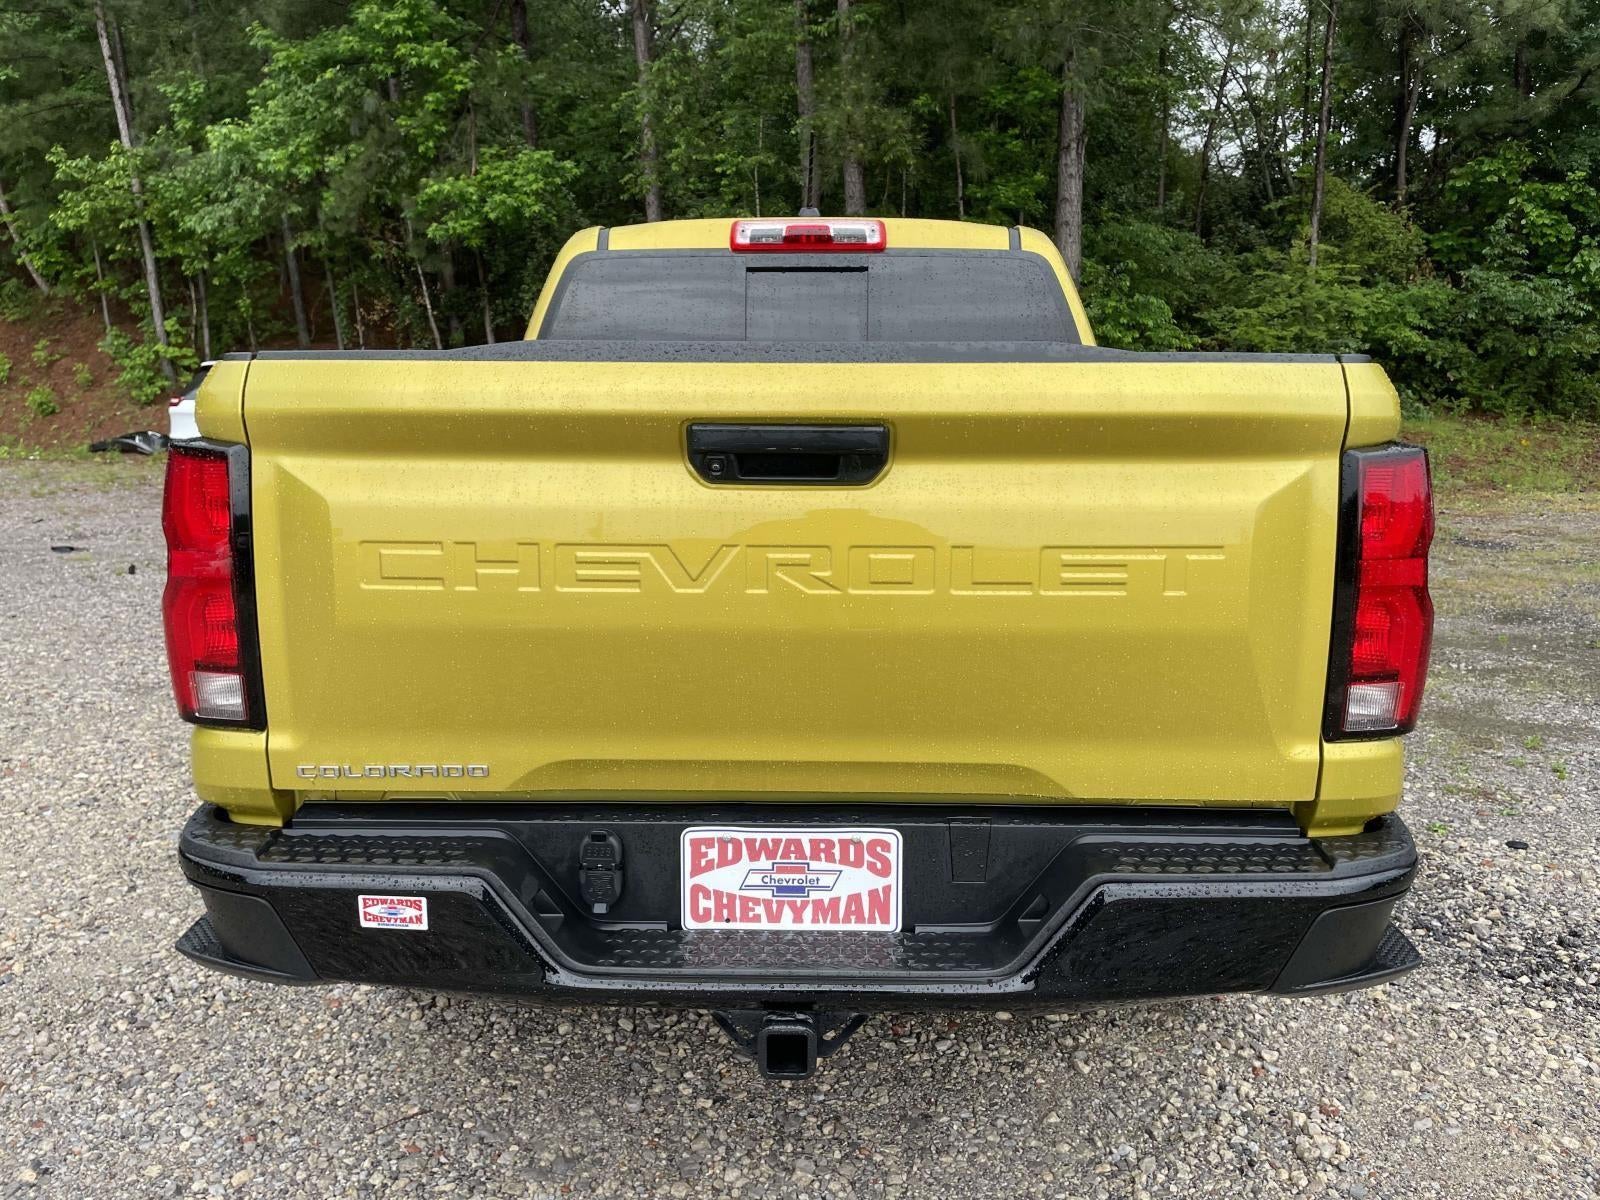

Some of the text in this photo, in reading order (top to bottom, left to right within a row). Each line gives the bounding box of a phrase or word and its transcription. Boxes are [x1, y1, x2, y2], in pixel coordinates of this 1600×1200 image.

[359, 540, 1226, 595] CHEVROLET
[296, 763, 490, 779] COLORADO
[689, 836, 892, 879] EDWARDS
[761, 874, 820, 886] Chevrolet
[362, 898, 422, 912] EDWARDS
[689, 883, 892, 925] CHEVYMAN
[363, 911, 423, 924] CHEVYMAN
